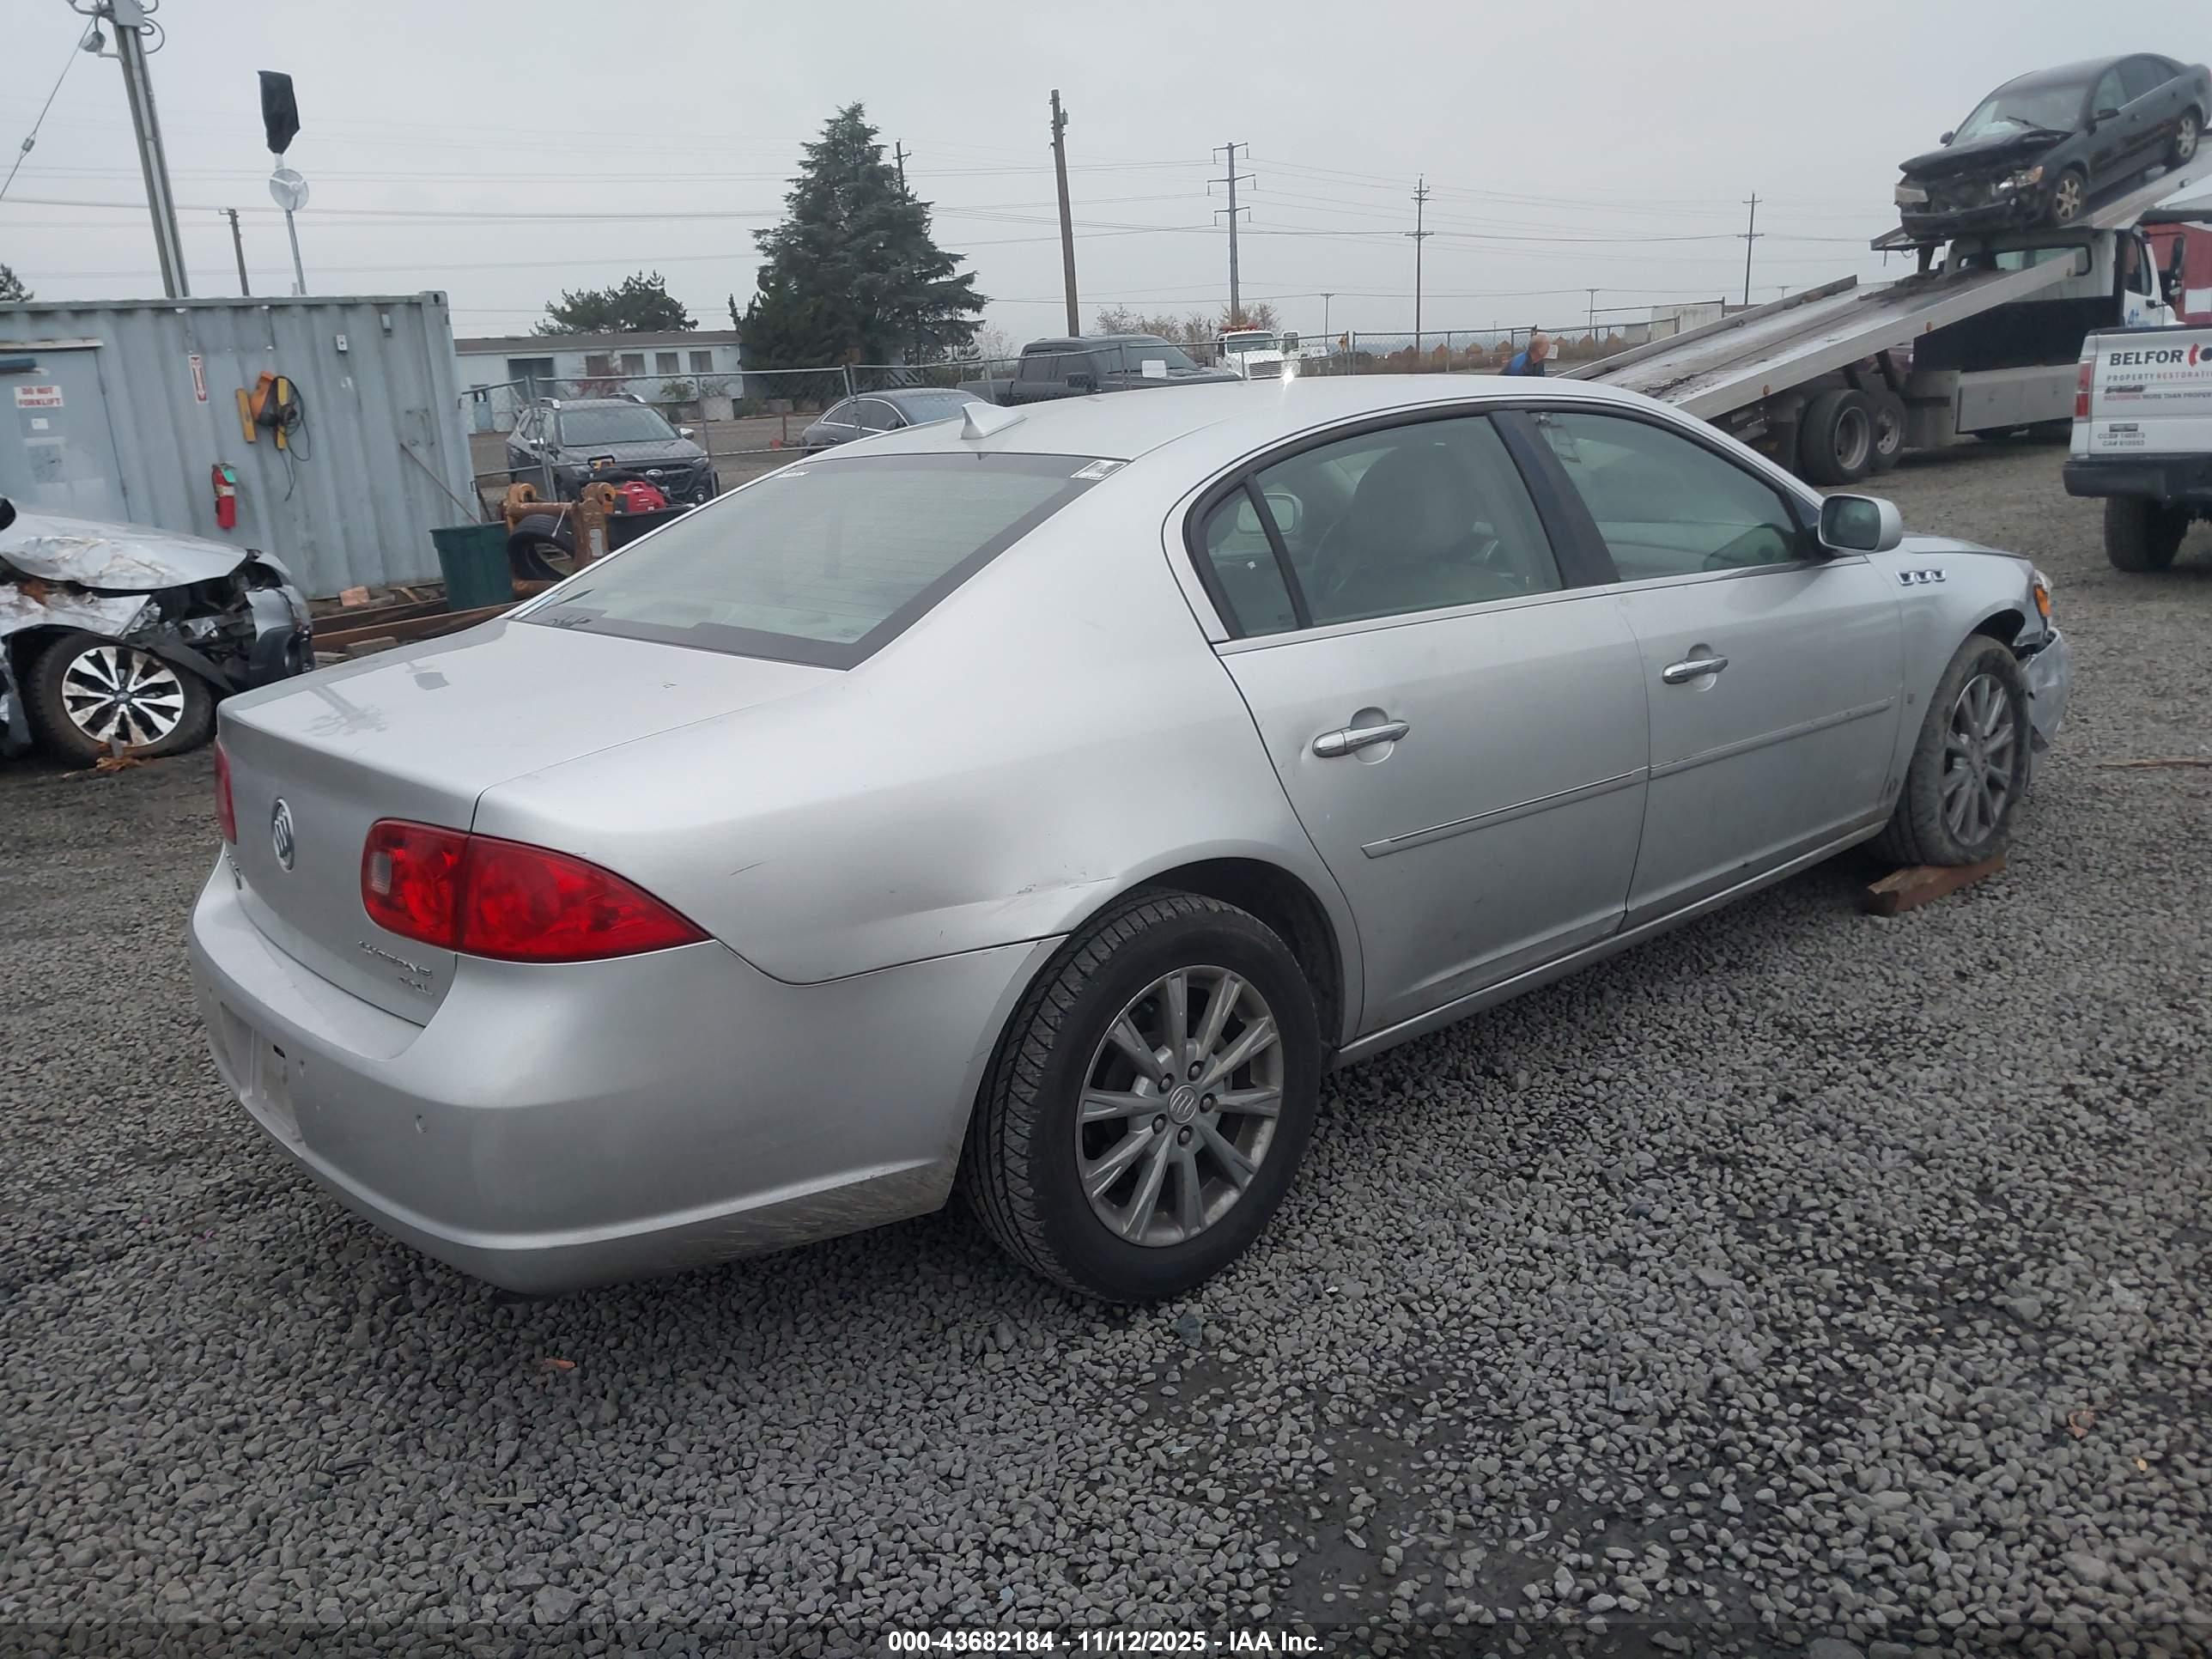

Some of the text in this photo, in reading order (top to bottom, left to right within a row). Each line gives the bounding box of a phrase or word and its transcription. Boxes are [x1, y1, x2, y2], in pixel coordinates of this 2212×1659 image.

[2109, 349, 2185, 367] BELFOR
[2106, 371, 2212, 382] PROPERTY RESTORATI
[21, 386, 54, 395] DO NOT
[18, 398, 61, 406] FORKLIFT
